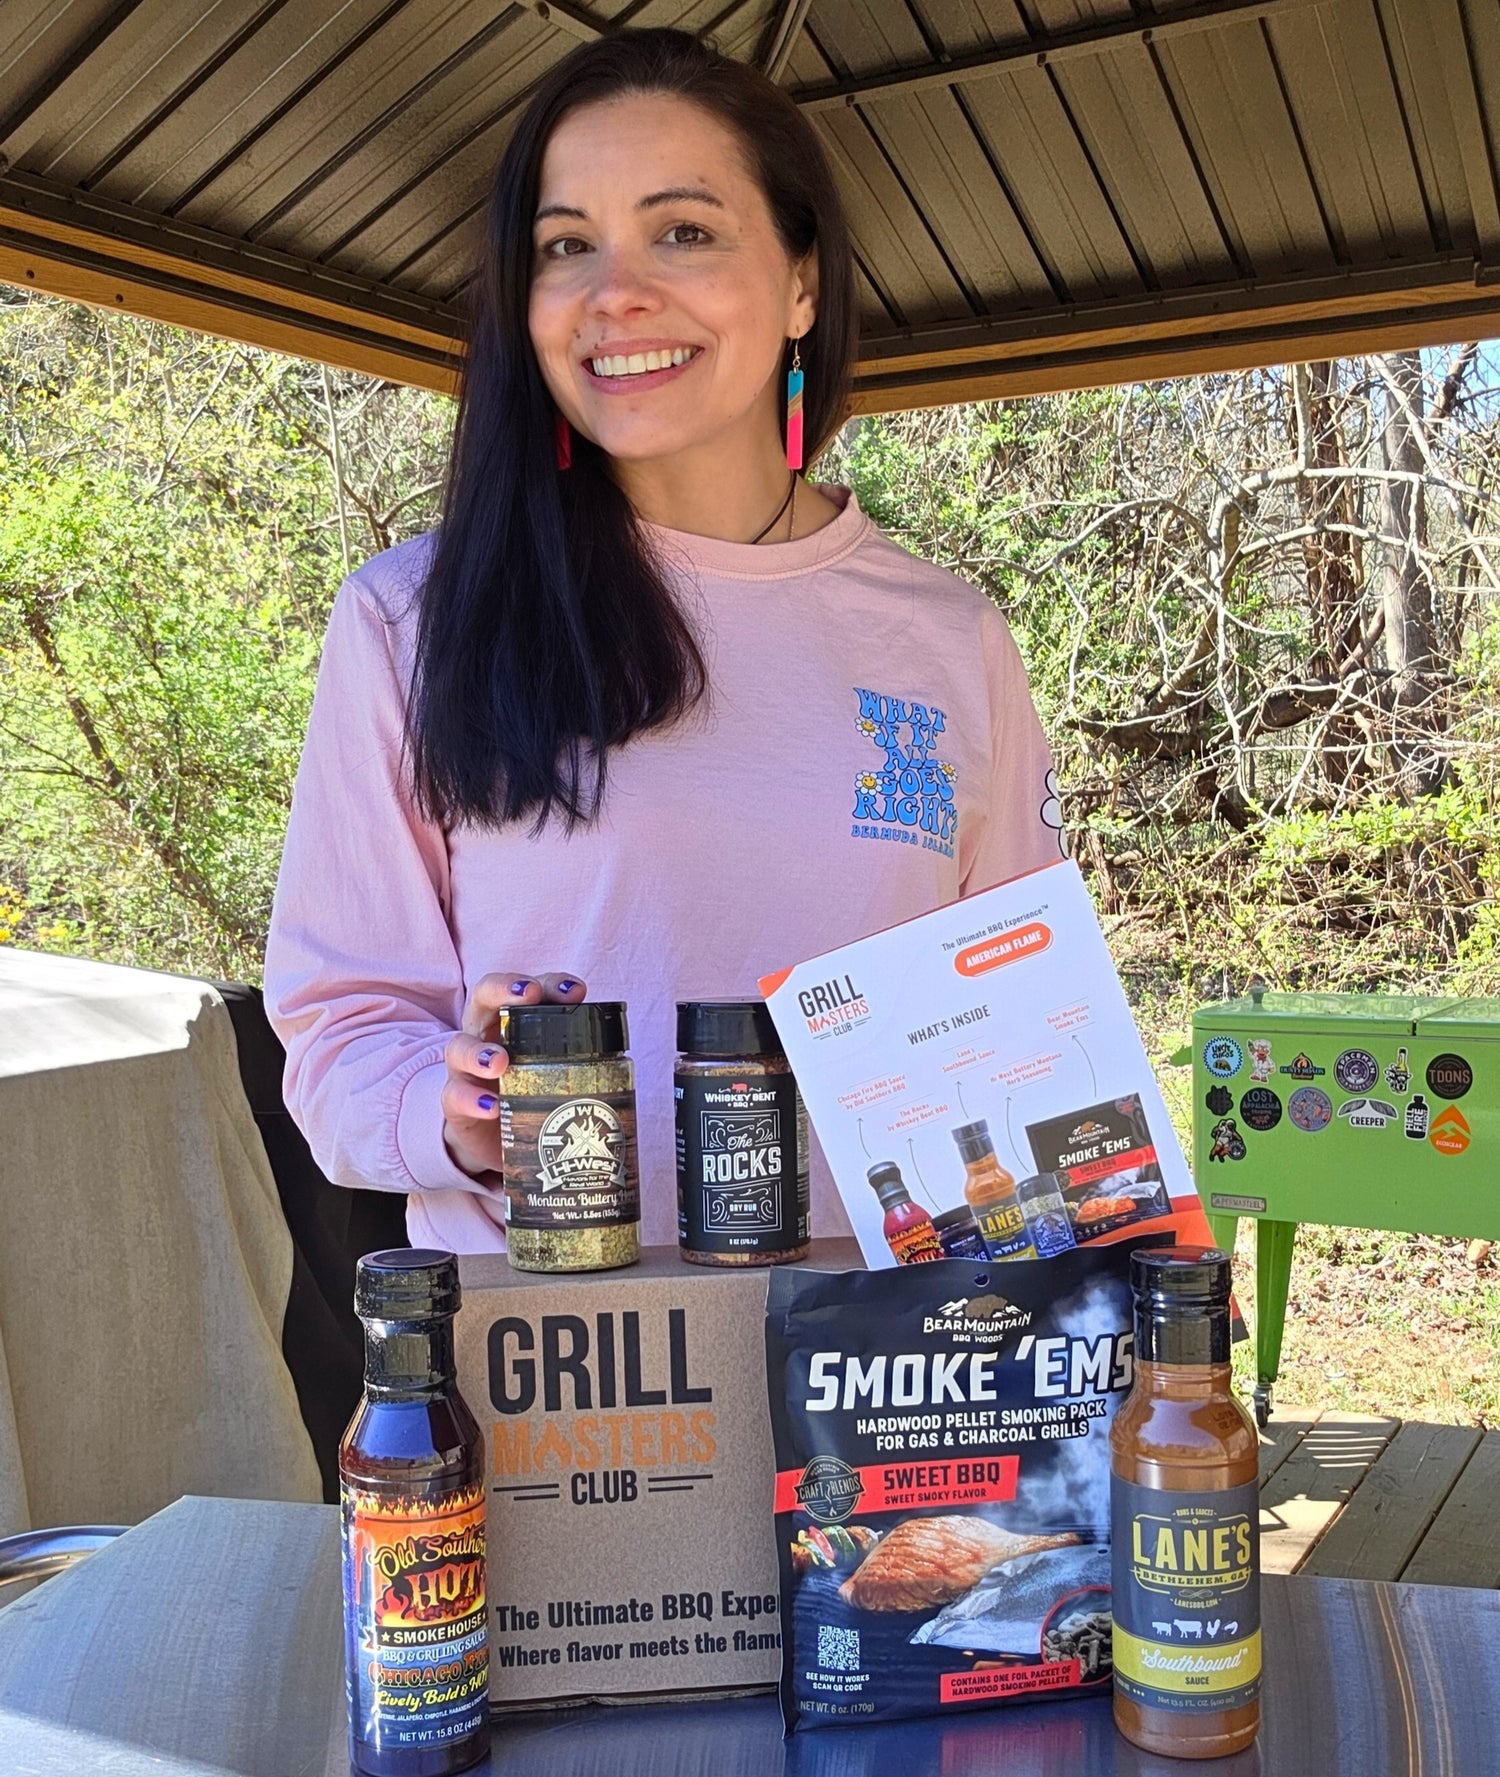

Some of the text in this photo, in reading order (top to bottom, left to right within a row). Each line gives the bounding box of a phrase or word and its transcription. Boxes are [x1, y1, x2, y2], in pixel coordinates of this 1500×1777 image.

[853, 687, 947, 732] WHAT
[911, 724, 938, 750] IT
[883, 744, 941, 772] ALL
[876, 767, 954, 801] GOES
[851, 824, 919, 845] BERMUDA
[942, 940, 955, 951] The
[956, 930, 987, 946] Ultimate
[987, 922, 1003, 935] BBQ
[965, 930, 1043, 968] AMERICAN FLAME
[798, 975, 864, 1018] GRILL
[833, 1022, 853, 1036] CLUB
[907, 1005, 991, 1045] WHAT'S INSIDE
[1338, 1052, 1376, 1075] SPACEMAN
[705, 1091, 776, 1103] WHISKEY BENT
[1247, 1091, 1273, 1102] LOST
[1351, 1116, 1385, 1127] CREEPER
[1413, 1108, 1424, 1132] FIRE
[727, 1133, 752, 1150] The
[702, 1146, 782, 1183] ROCKS
[1058, 1146, 1100, 1168] SMOKE
[527, 1194, 577, 1207] Montana
[578, 1192, 617, 1207] Buttery
[729, 1203, 742, 1212] DRY
[977, 1205, 1023, 1234] LANE'S
[924, 1312, 1032, 1334] BEAR MOUNTAIN
[953, 1333, 1003, 1343] BBQ WOODS
[487, 1309, 713, 1415] GRILL
[805, 1333, 1134, 1412] SMOKE 'EMS
[857, 1400, 1106, 1435] HARDWOOD PELLET SMOKING PACK
[492, 1410, 716, 1477] MASTERS
[876, 1421, 1089, 1451] FOR GAS & CHARCOAL GRILLS
[571, 1470, 638, 1506] CLUB
[799, 1476, 861, 1500] CRAFT BLENDS
[884, 1462, 1001, 1491] SWEET BBQ
[885, 1487, 988, 1505] SWEET SMOKY FLAVOR
[371, 1536, 419, 1577] Old
[1133, 1521, 1251, 1571] LANE'S
[1231, 1571, 1244, 1581] GA
[496, 1604, 540, 1632] The
[548, 1598, 654, 1629] Ultimate
[662, 1591, 713, 1622] BBQ
[383, 1650, 407, 1666] BBQ
[407, 1650, 416, 1662] &
[499, 1645, 561, 1668] Where
[566, 1640, 621, 1664] flavor
[629, 1636, 690, 1659] meets
[695, 1633, 728, 1655] the
[368, 1661, 462, 1688] CHICAGO
[805, 1672, 870, 1683] SEE HOW IT WORKS
[950, 1665, 1072, 1687] CONTAINS ONE FOIL PACKET OF
[952, 1675, 1071, 1697] HARDWOOD SMOKING PELLETS
[1185, 1676, 1210, 1685] SAUCE
[377, 1690, 423, 1713] Lively,
[423, 1686, 459, 1705] Bold
[460, 1683, 469, 1697] &
[812, 1682, 863, 1692] SCAN QR CODE
[800, 1700, 875, 1714] NET WT. 6 oz. (170g)
[400, 1732, 416, 1742] NET
[417, 1730, 435, 1741] WT.
[436, 1726, 453, 1739] 15.8
[454, 1723, 464, 1735] OZ
